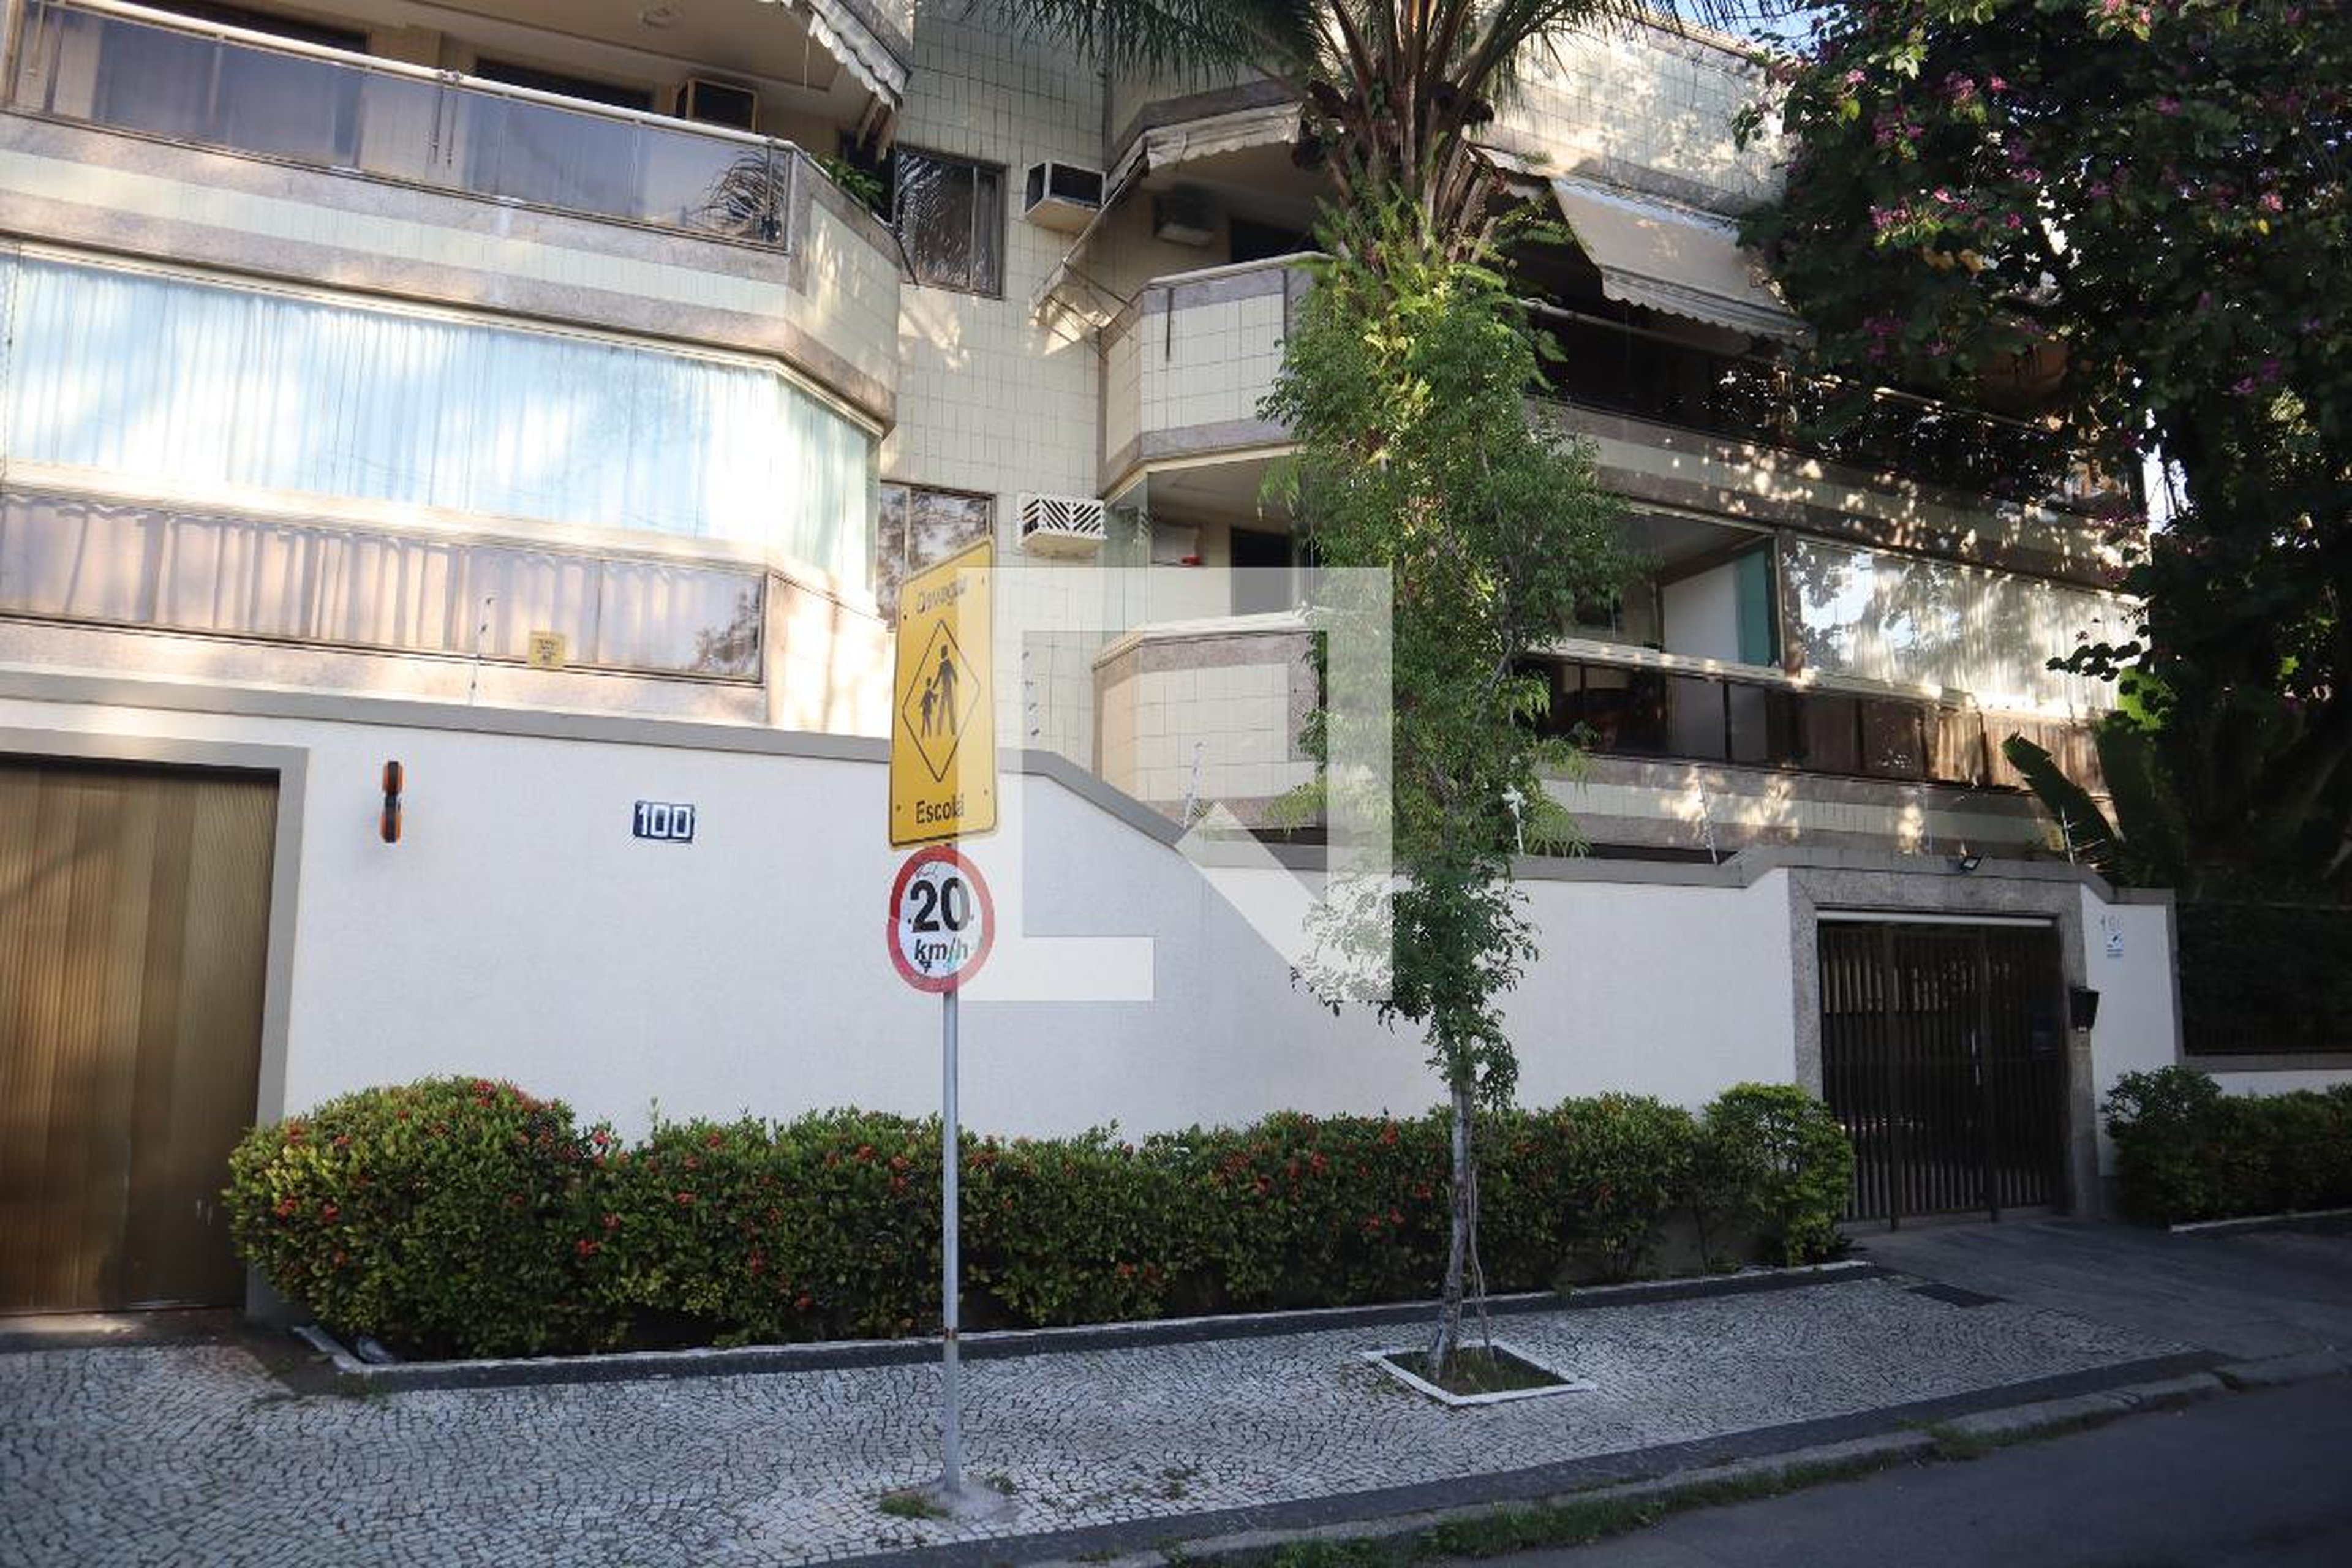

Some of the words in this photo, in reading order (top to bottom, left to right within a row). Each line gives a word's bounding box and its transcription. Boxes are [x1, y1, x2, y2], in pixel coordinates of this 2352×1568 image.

[638, 803, 692, 838] 100
[916, 793, 964, 824] Escola
[910, 876, 970, 933] 20
[914, 937, 969, 961] km/h
